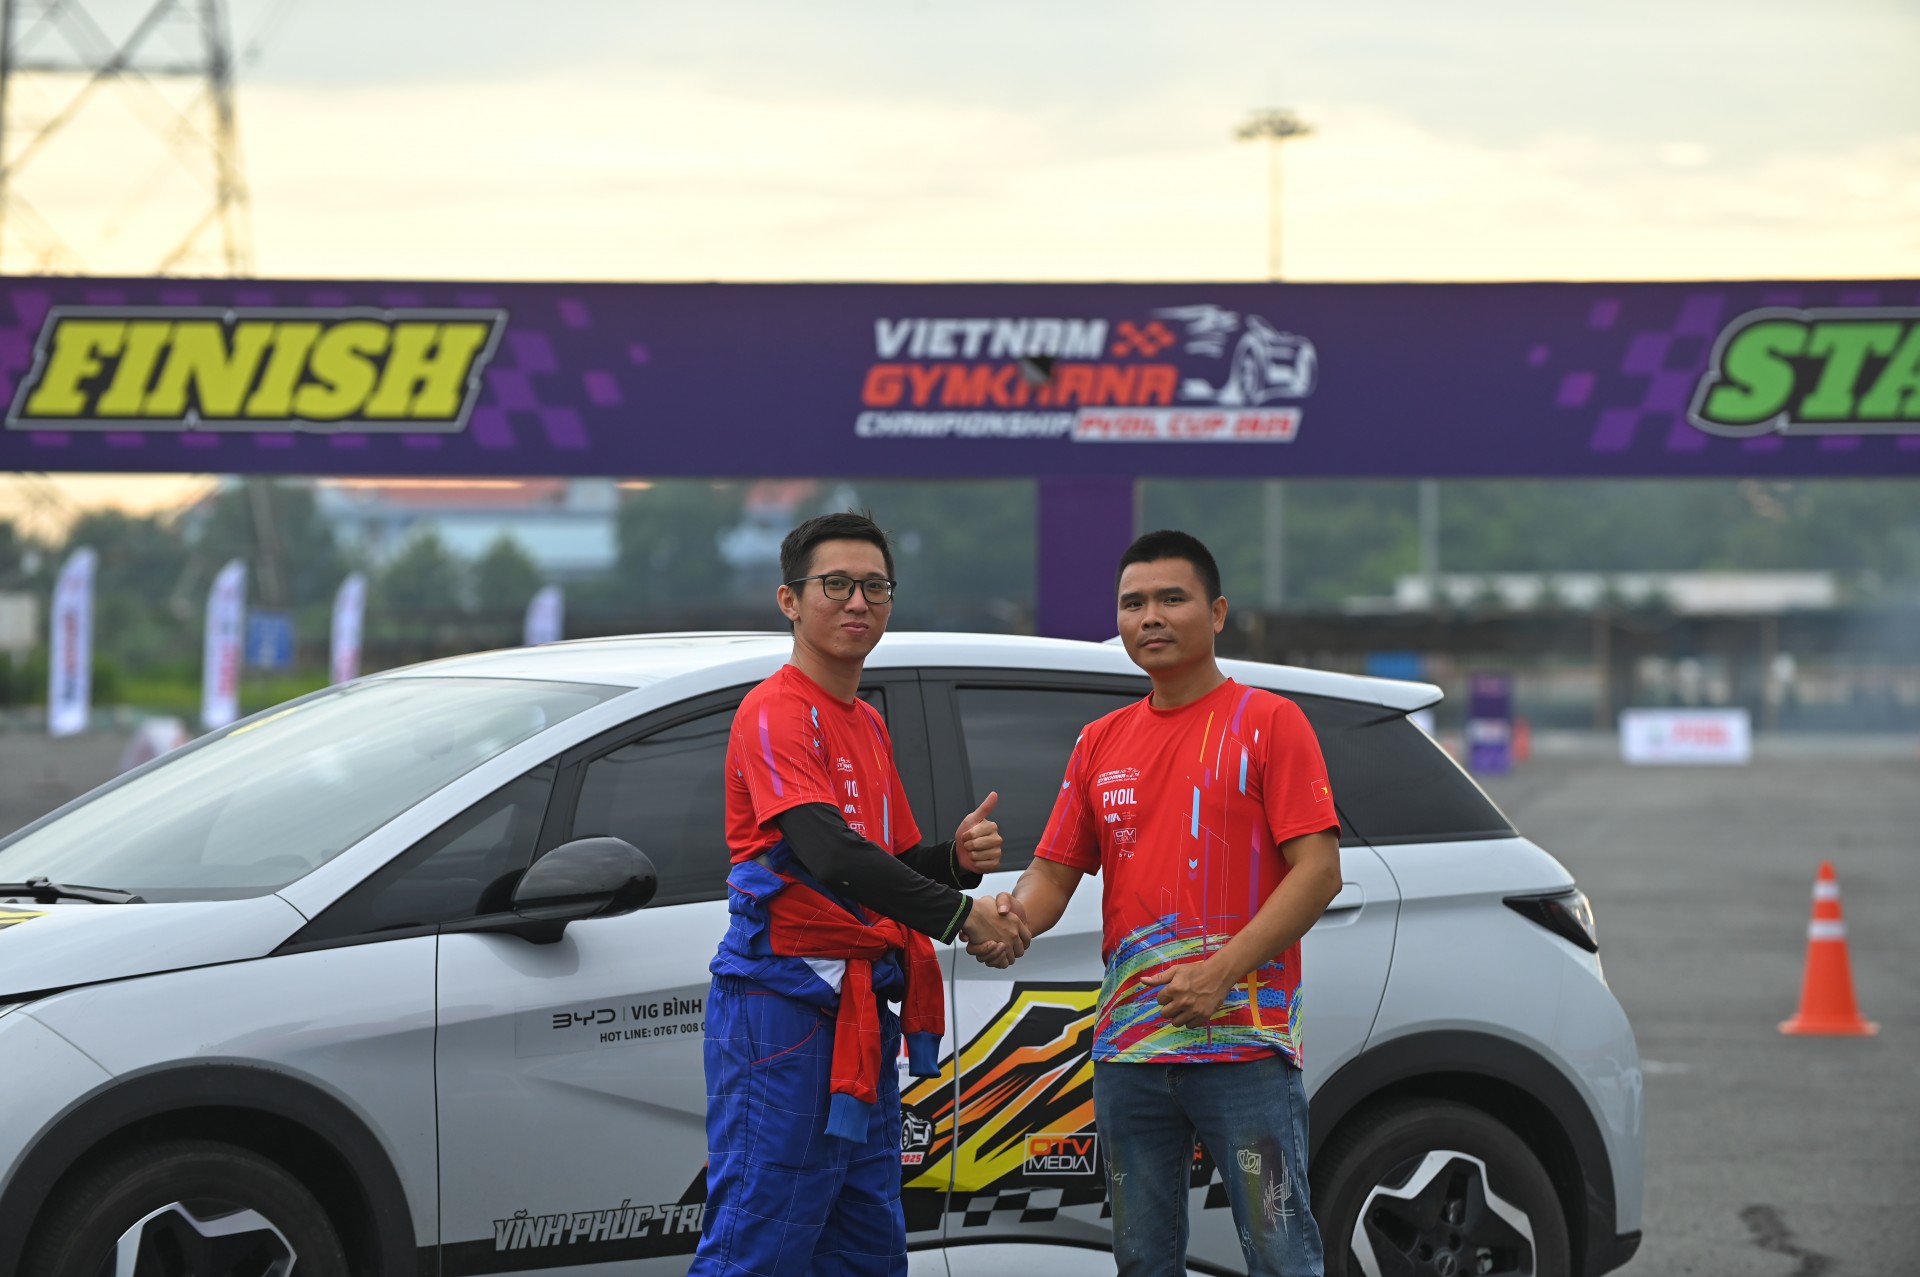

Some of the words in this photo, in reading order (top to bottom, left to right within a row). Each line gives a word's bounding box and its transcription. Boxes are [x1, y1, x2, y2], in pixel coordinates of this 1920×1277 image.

[874, 317, 1109, 359] VIETNAM
[26, 320, 488, 419] FINISH
[855, 411, 1075, 438] CHAMPIONSHIP
[1165, 412, 1228, 439] CUP
[1103, 788, 1137, 808] PVOIL
[552, 1008, 616, 1029] BYD
[631, 1003, 659, 1020] VIG
[663, 997, 702, 1017] BÌNH
[600, 1030, 621, 1043] HOT
[624, 1027, 652, 1040] LINE:
[653, 1024, 678, 1037] 0767
[680, 1022, 699, 1034] 008
[1029, 1137, 1093, 1156] OTV
[1028, 1155, 1092, 1173] MEDIA
[493, 1209, 568, 1251] VĨNH
[567, 1199, 655, 1245] PHÚC
